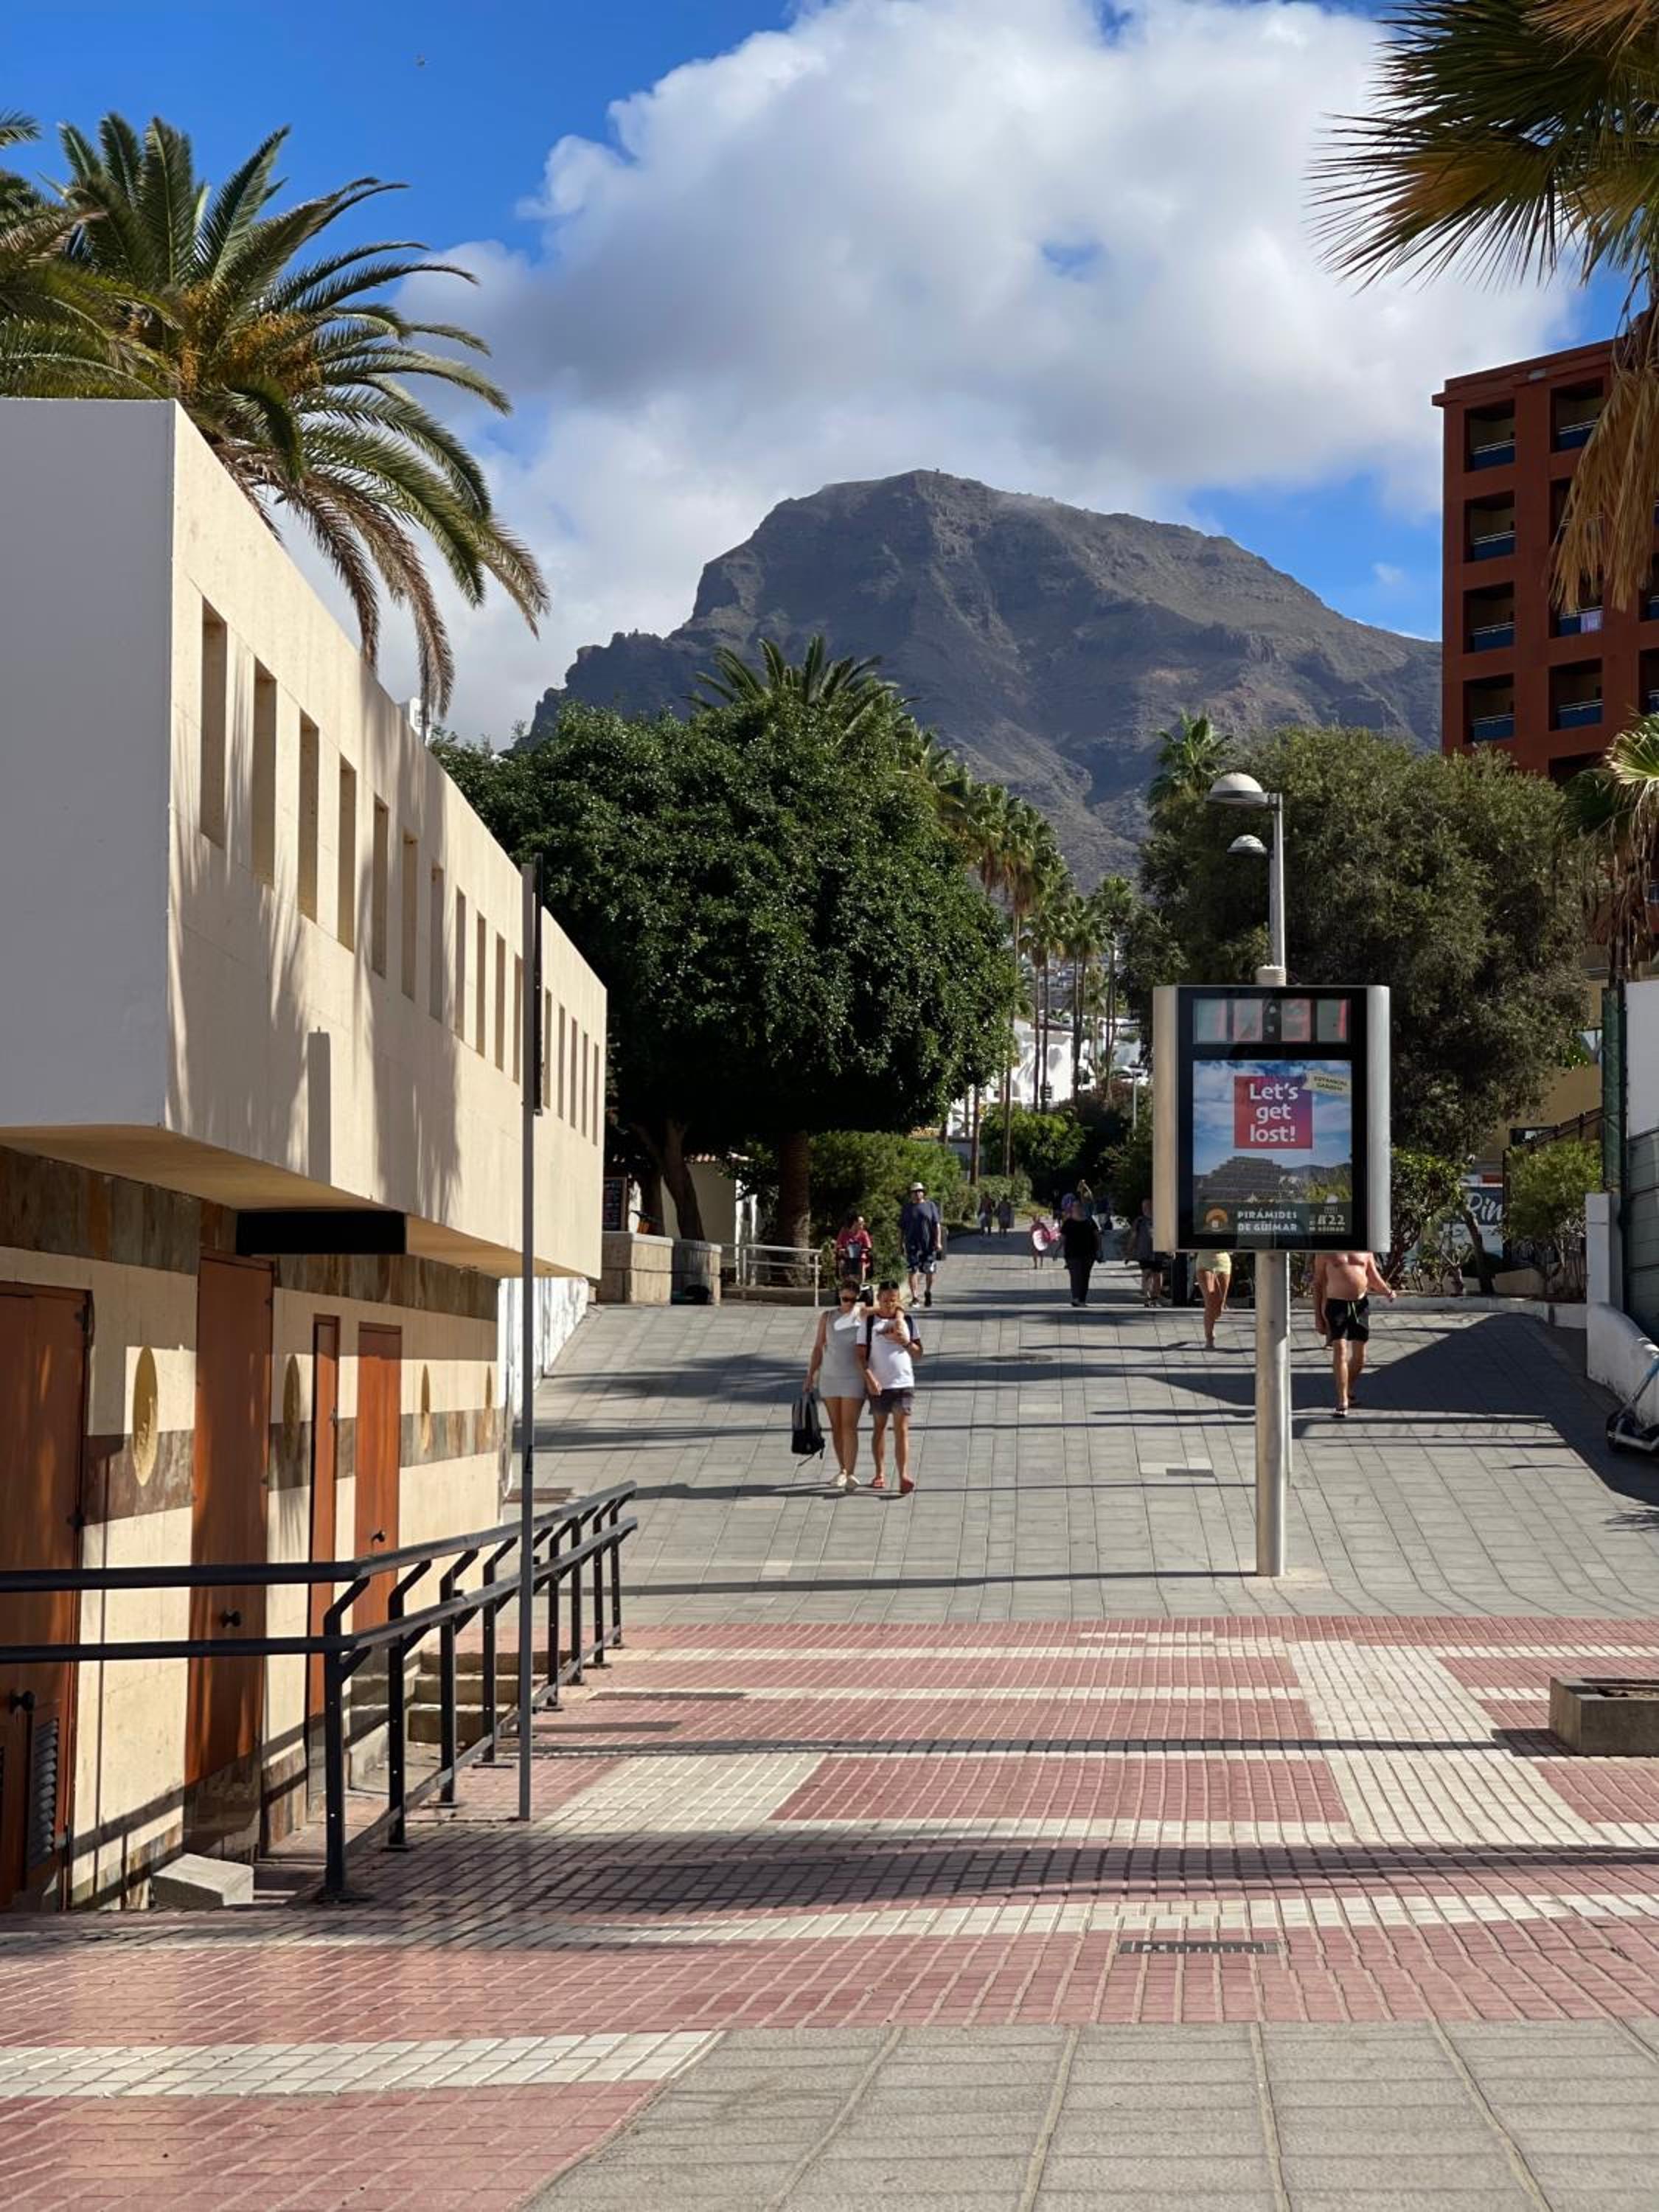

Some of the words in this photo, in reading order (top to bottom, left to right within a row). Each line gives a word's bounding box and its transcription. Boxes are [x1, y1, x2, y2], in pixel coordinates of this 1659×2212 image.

[1250, 1082, 1298, 1100] Let's
[1256, 1103, 1292, 1124] get
[1250, 1124, 1295, 1142] lost!
[1237, 1222, 1251, 1231] DE
